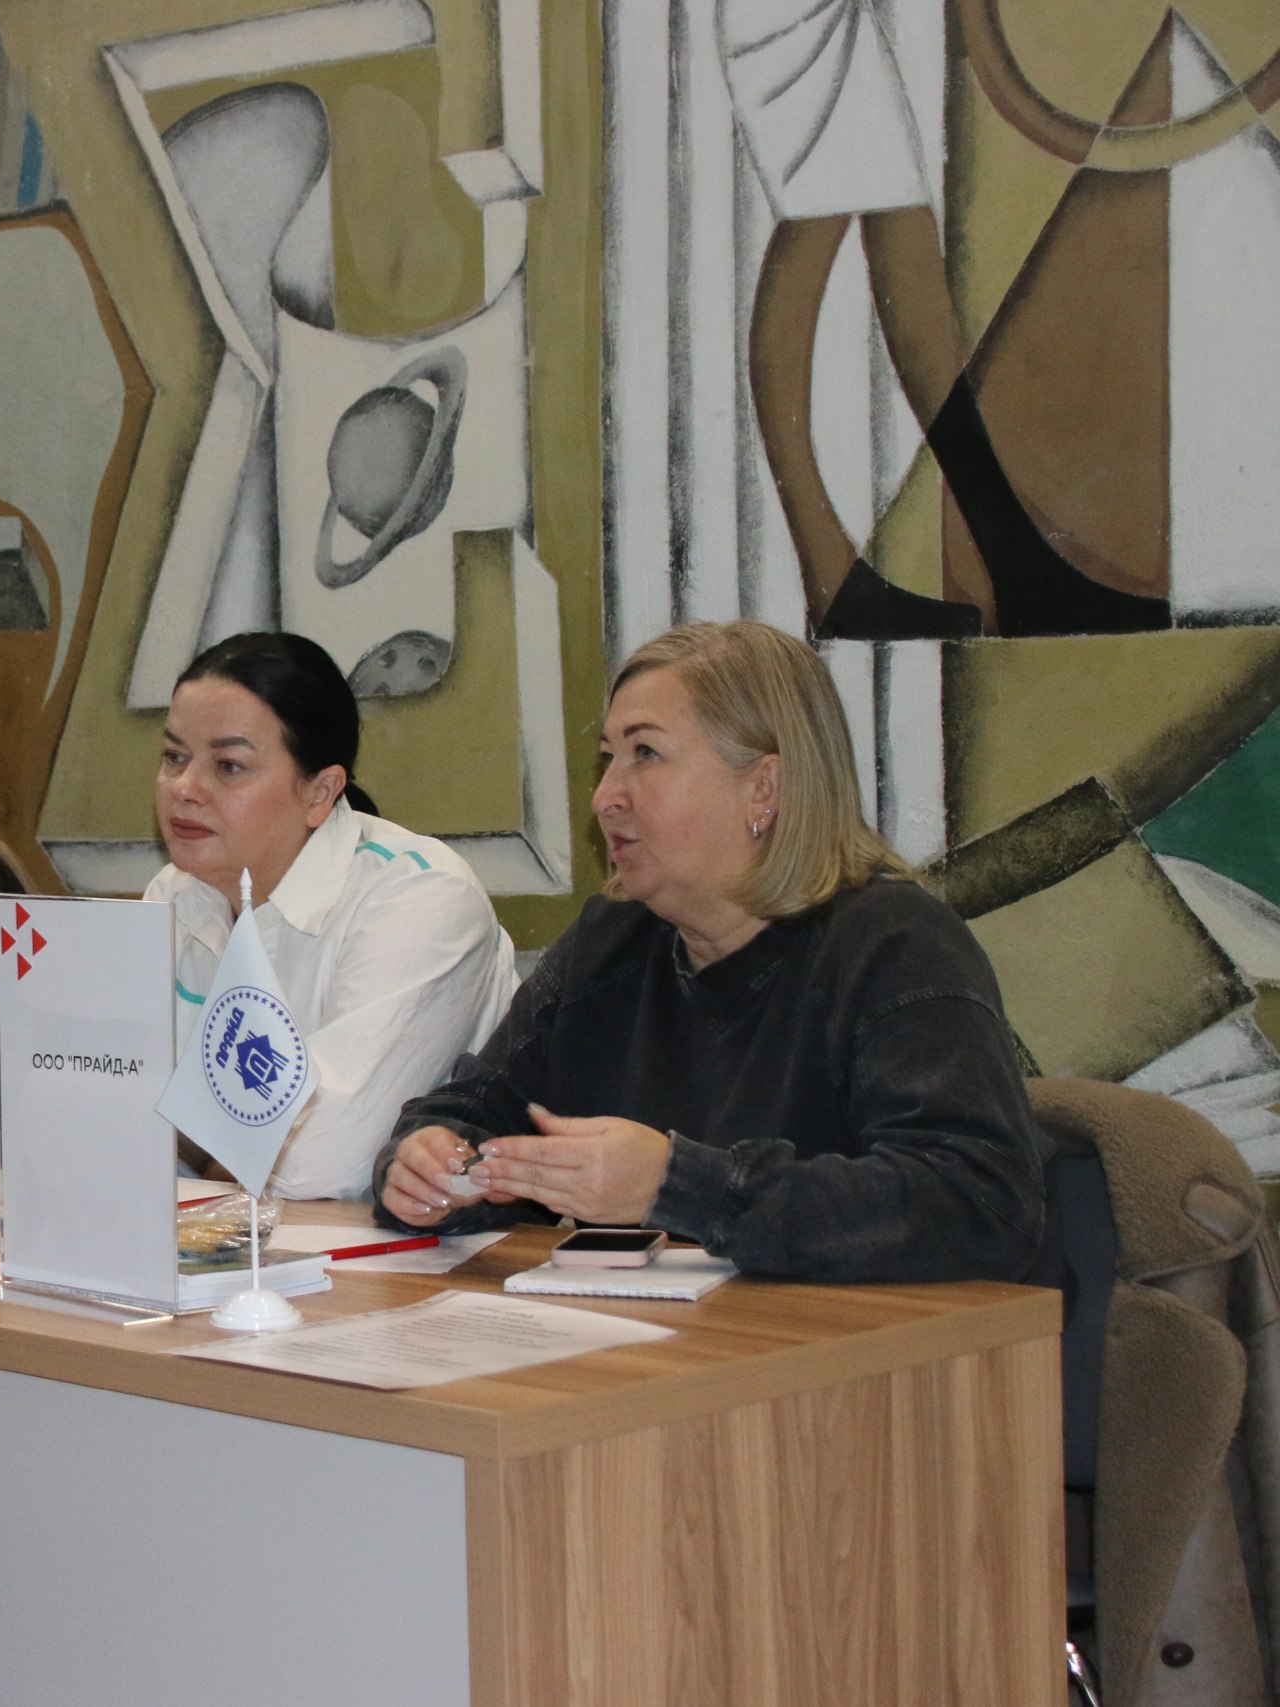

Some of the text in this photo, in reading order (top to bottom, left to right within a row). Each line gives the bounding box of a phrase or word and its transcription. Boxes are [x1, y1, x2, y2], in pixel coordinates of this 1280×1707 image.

[215, 1006, 245, 1070] ПРАЙД
[32, 1053, 144, 1077] ООО "ПРАЙД-А"
